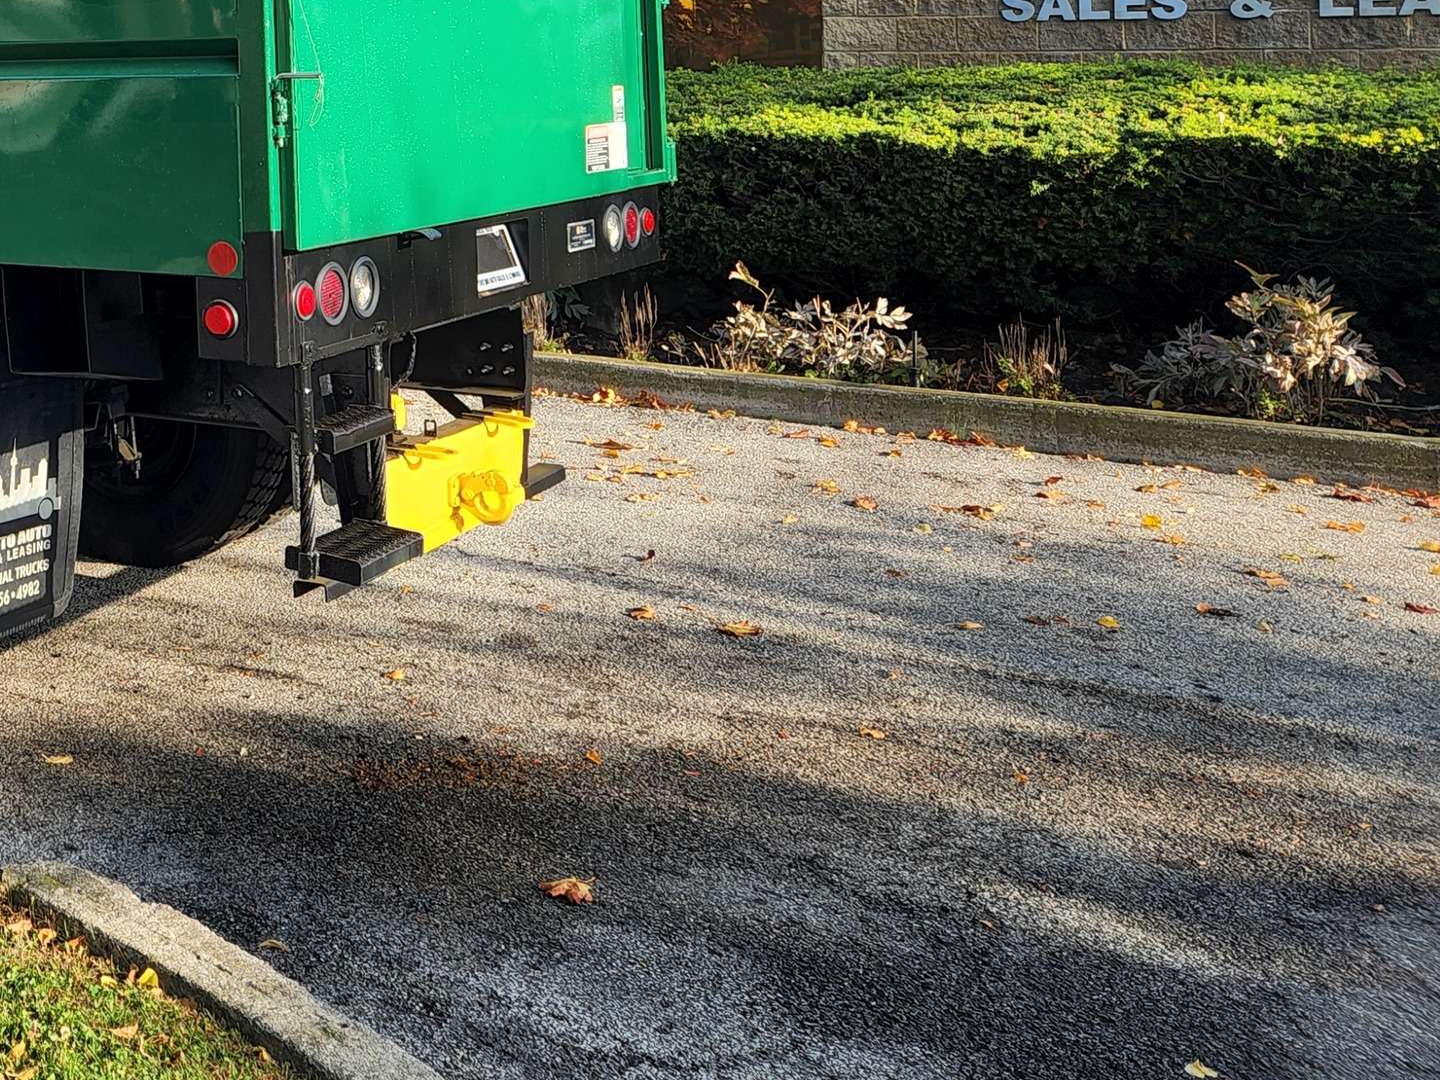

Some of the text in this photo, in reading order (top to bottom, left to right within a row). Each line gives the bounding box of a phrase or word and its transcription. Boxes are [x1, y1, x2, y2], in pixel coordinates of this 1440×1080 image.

[17, 524, 52, 545] AUTO
[6, 539, 51, 561] LEASING
[15, 558, 50, 579] TRUCKS
